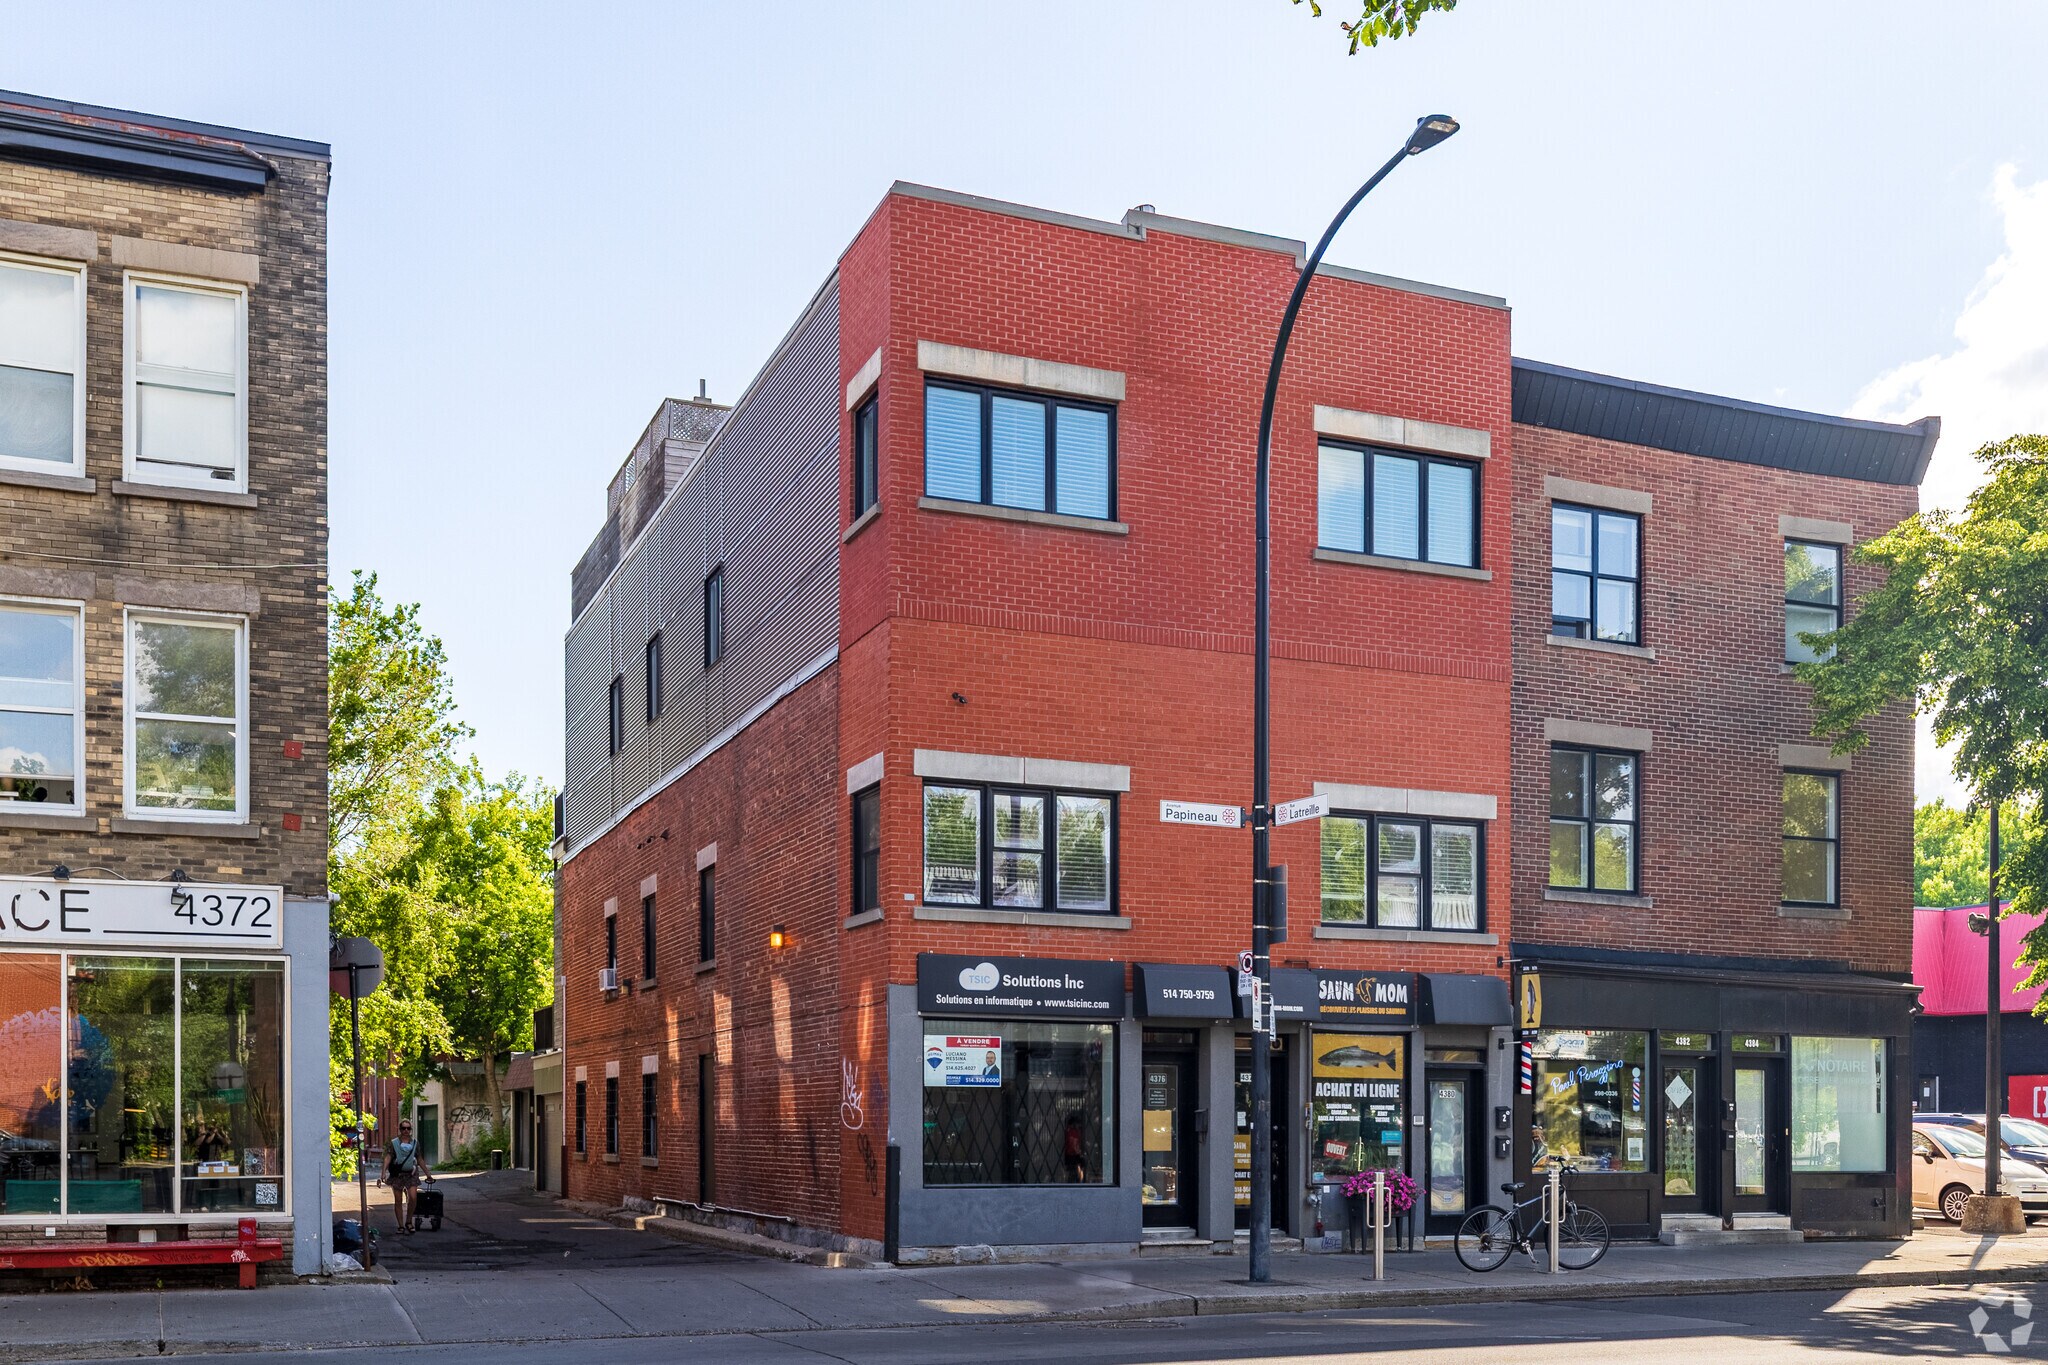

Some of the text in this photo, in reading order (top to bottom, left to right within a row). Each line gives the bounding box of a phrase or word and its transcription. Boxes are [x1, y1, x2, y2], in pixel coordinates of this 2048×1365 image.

[1165, 808, 1218, 822] Papineau
[1289, 804, 1320, 819] Latreille
[0, 889, 272, 932] CE 4372
[968, 975, 991, 984] TSIC
[1002, 973, 1085, 989] Solutions Inc
[1163, 989, 1215, 1000] 514 750-9759
[1318, 980, 1408, 1004] SAUM MOM
[936, 994, 1110, 1009] Solutions en informatique www.tsicinc.com
[1675, 1037, 1691, 1046] 4382
[1744, 1039, 1760, 1048] 4384
[1817, 1060, 1868, 1072] NOTAIRE
[1149, 1075, 1166, 1083] 4376
[1315, 1082, 1400, 1098] ACHAT EN LIGNE
[1502, 1114, 1507, 1122] 2
[1326, 1142, 1348, 1156] OUVERT
[1502, 1143, 1506, 1152] 1
